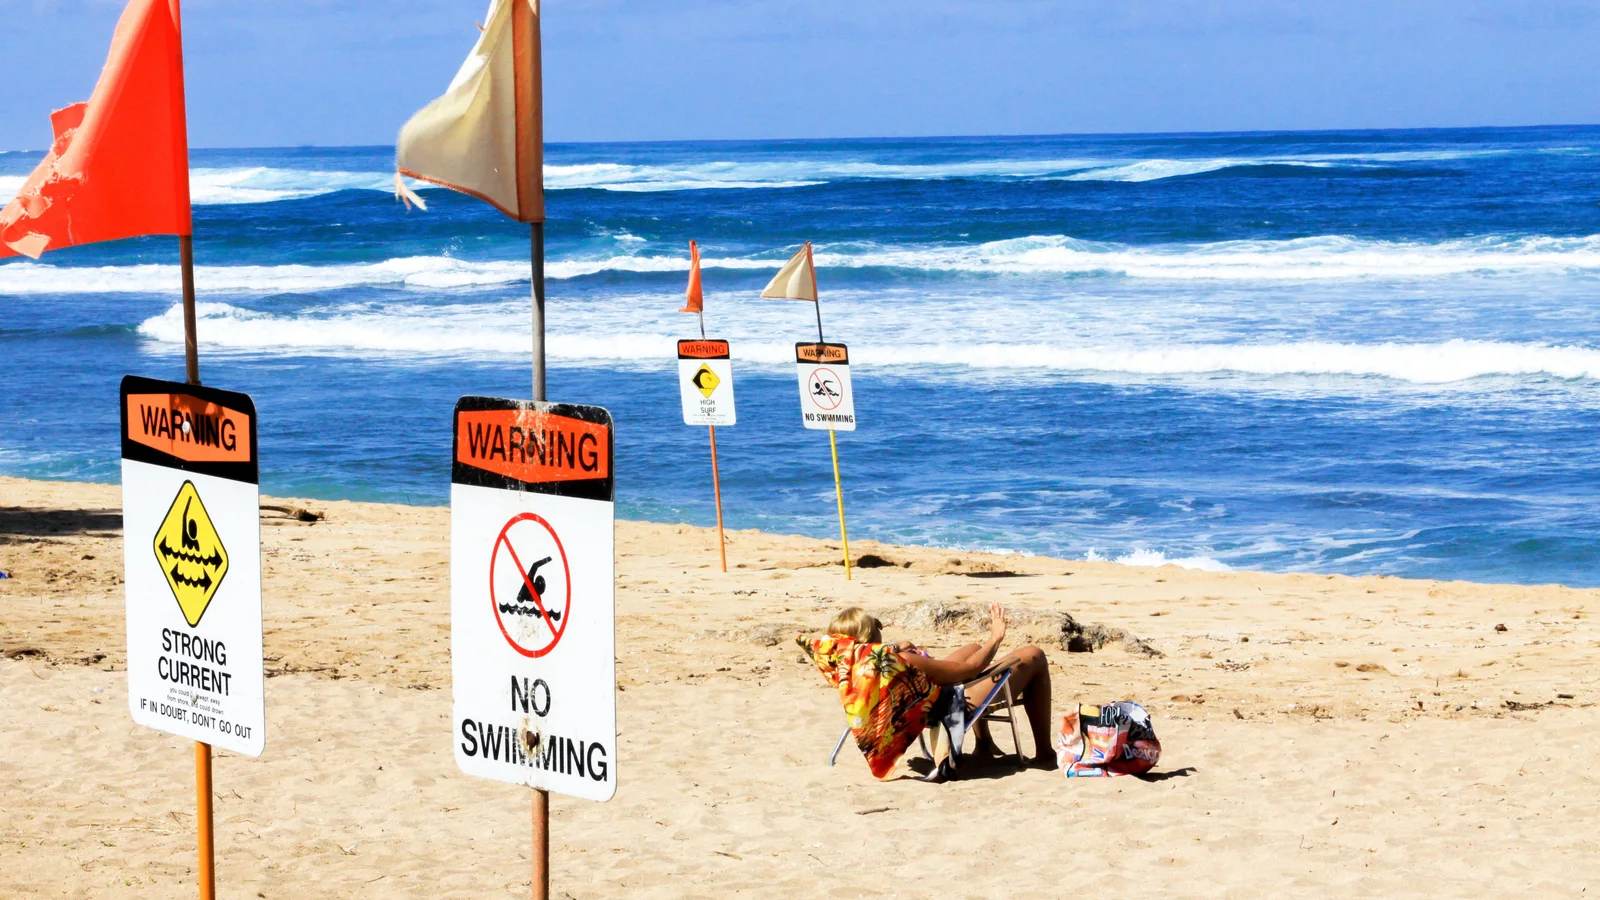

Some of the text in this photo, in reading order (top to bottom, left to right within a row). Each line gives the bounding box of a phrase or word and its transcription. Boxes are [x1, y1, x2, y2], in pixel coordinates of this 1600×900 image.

[683, 345, 725, 354] WARNING
[803, 349, 841, 358] WARNING
[140, 403, 236, 452] WARNING
[700, 406, 716, 414] SURF
[805, 413, 854, 423] NO SWIMMING
[467, 421, 599, 472] WARNING
[162, 627, 227, 666] STRONG
[158, 656, 232, 696] CURRENT
[511, 675, 551, 717] NO
[140, 697, 252, 739] IF IN DOUBT, DON'T GO OUT
[461, 718, 608, 782] SWIMMING
